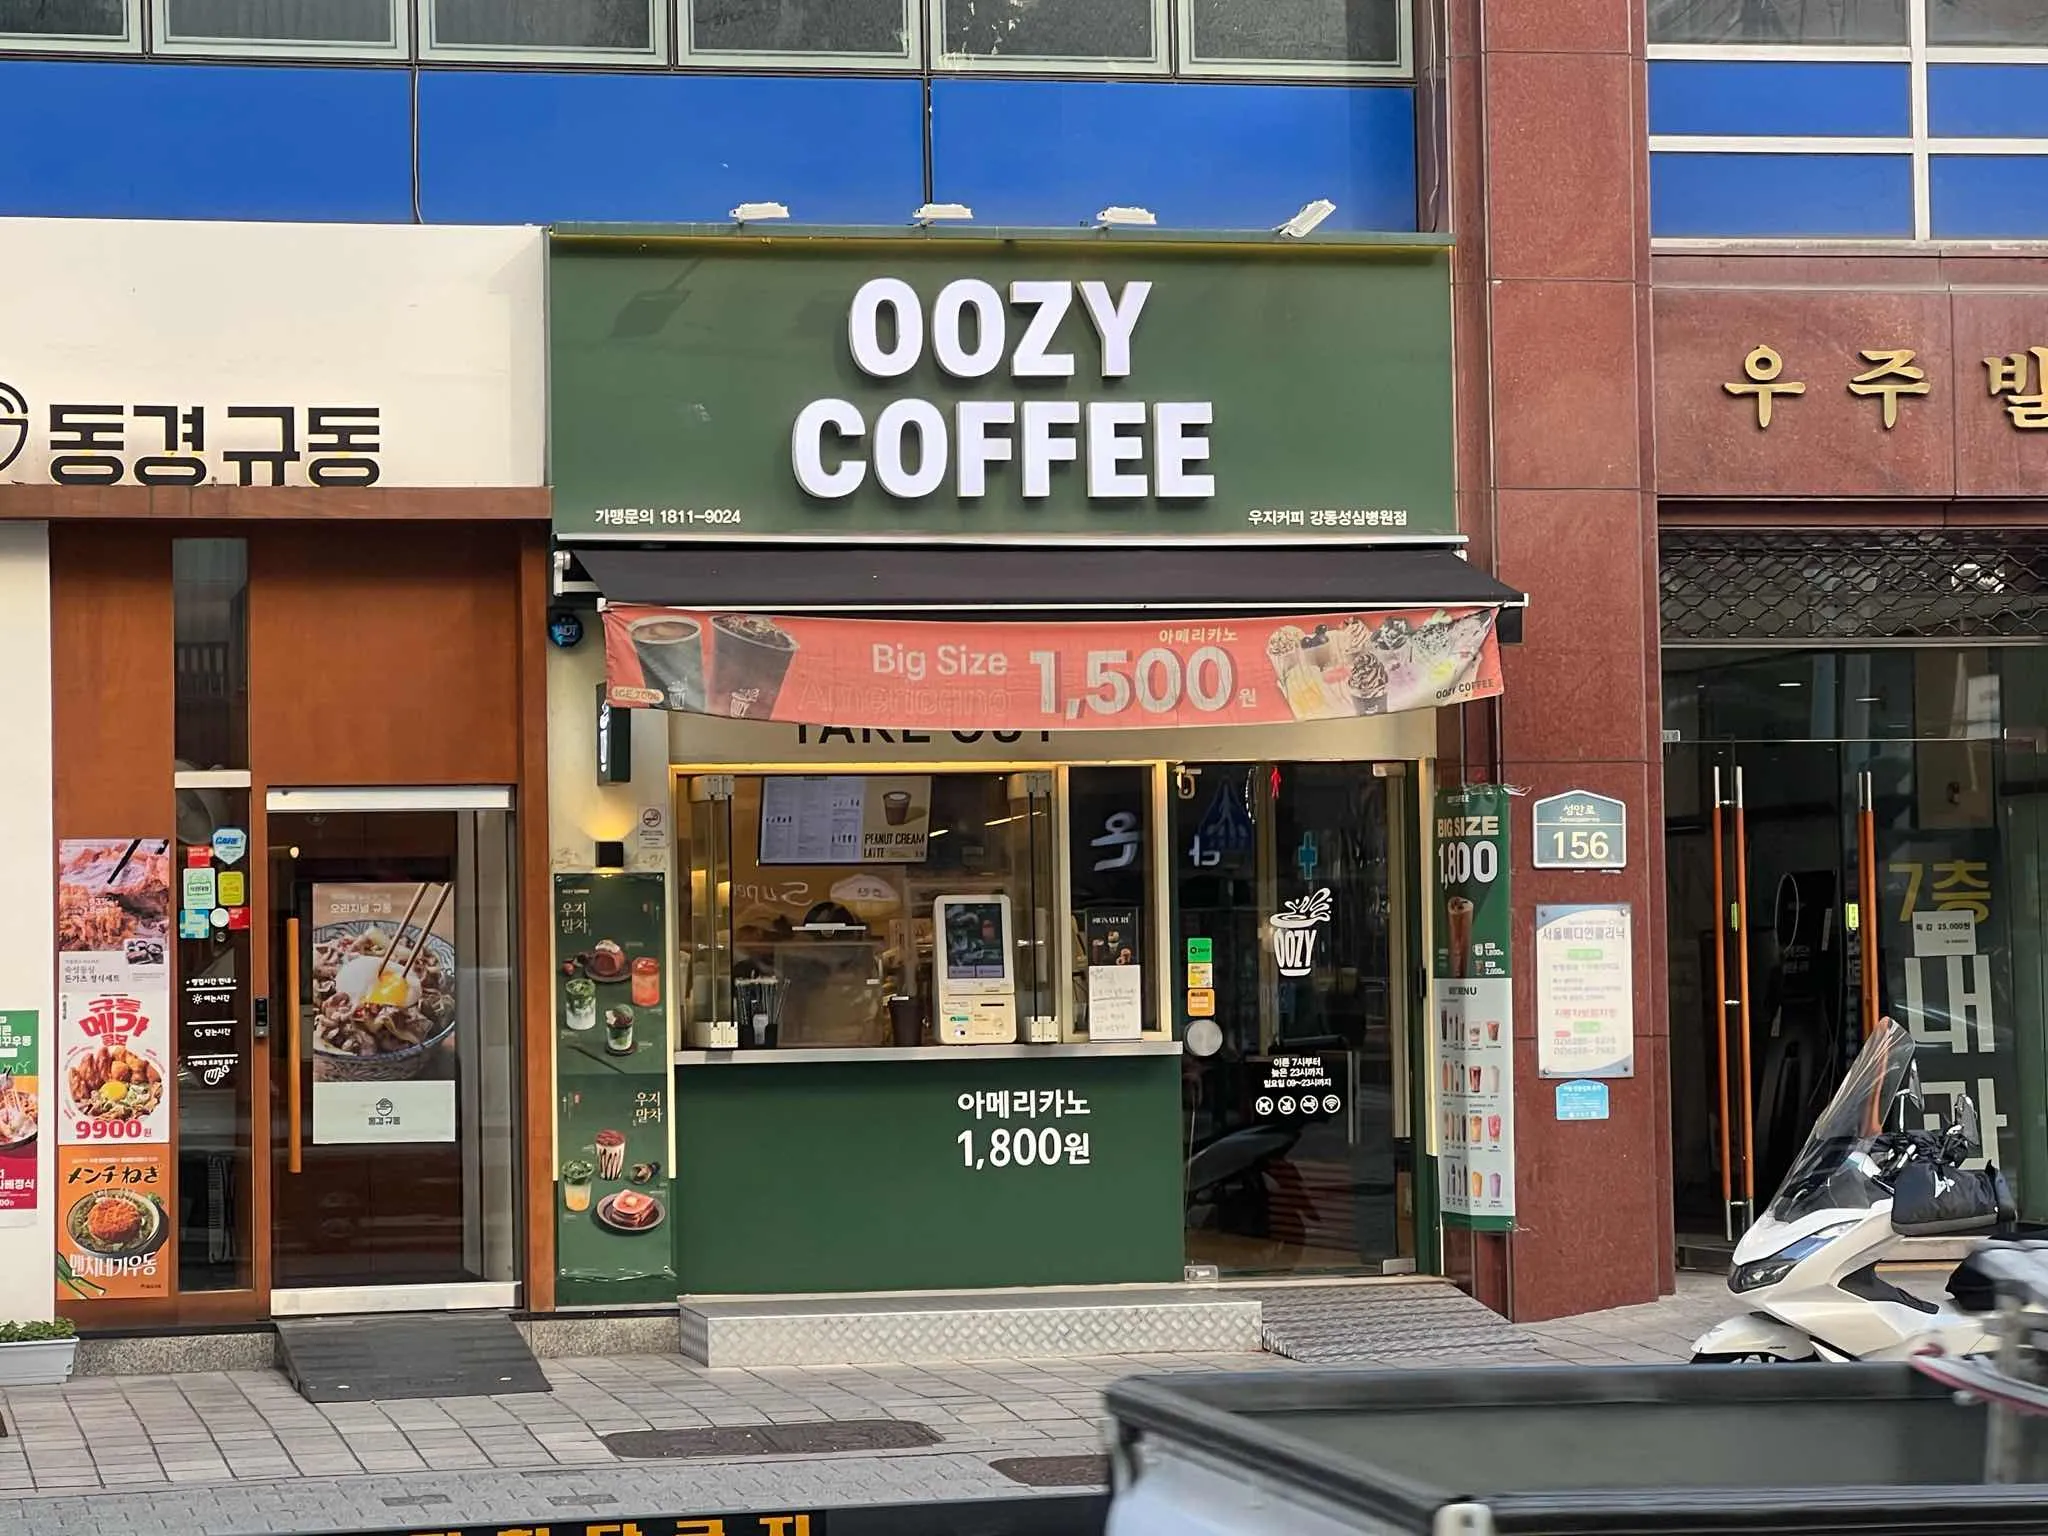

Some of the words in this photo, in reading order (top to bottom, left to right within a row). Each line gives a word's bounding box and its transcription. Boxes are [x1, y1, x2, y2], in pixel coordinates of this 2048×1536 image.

[848, 278, 1153, 377] OOZY
[50, 403, 380, 487] 동경규동
[792, 399, 1215, 498] COFFEE
[595, 508, 654, 526] 가맹문의
[660, 508, 741, 525] 1811-9024
[1248, 509, 1304, 526] 우지커피
[1310, 508, 1408, 526] 강동성심병원점
[1159, 628, 1238, 644] 아메리카노
[872, 644, 926, 681] Big
[936, 644, 1008, 675] Size
[1438, 818, 1453, 838] BIG
[1454, 815, 1499, 838] SIZE
[865, 833, 893, 846] PEANUT
[895, 832, 926, 846] CREAM
[1553, 831, 1609, 860] 156
[1438, 840, 1498, 890] 1,800
[1888, 859, 1992, 925] 7층
[560, 901, 587, 917] 우지
[1273, 929, 1317, 968] OOZY
[78, 1012, 150, 1037] 메가
[1271, 1068, 1288, 1078] 늦은
[1290, 1067, 1324, 1077] 23시까지
[1273, 1057, 1290, 1067] 이른
[1292, 1056, 1321, 1067] 7시부터
[1264, 1079, 1285, 1089] 일요일
[635, 1091, 661, 1107] 우지
[957, 1088, 1091, 1120] 아메리카노
[636, 1107, 663, 1123] 말차
[957, 1127, 1091, 1170] 1,800원
